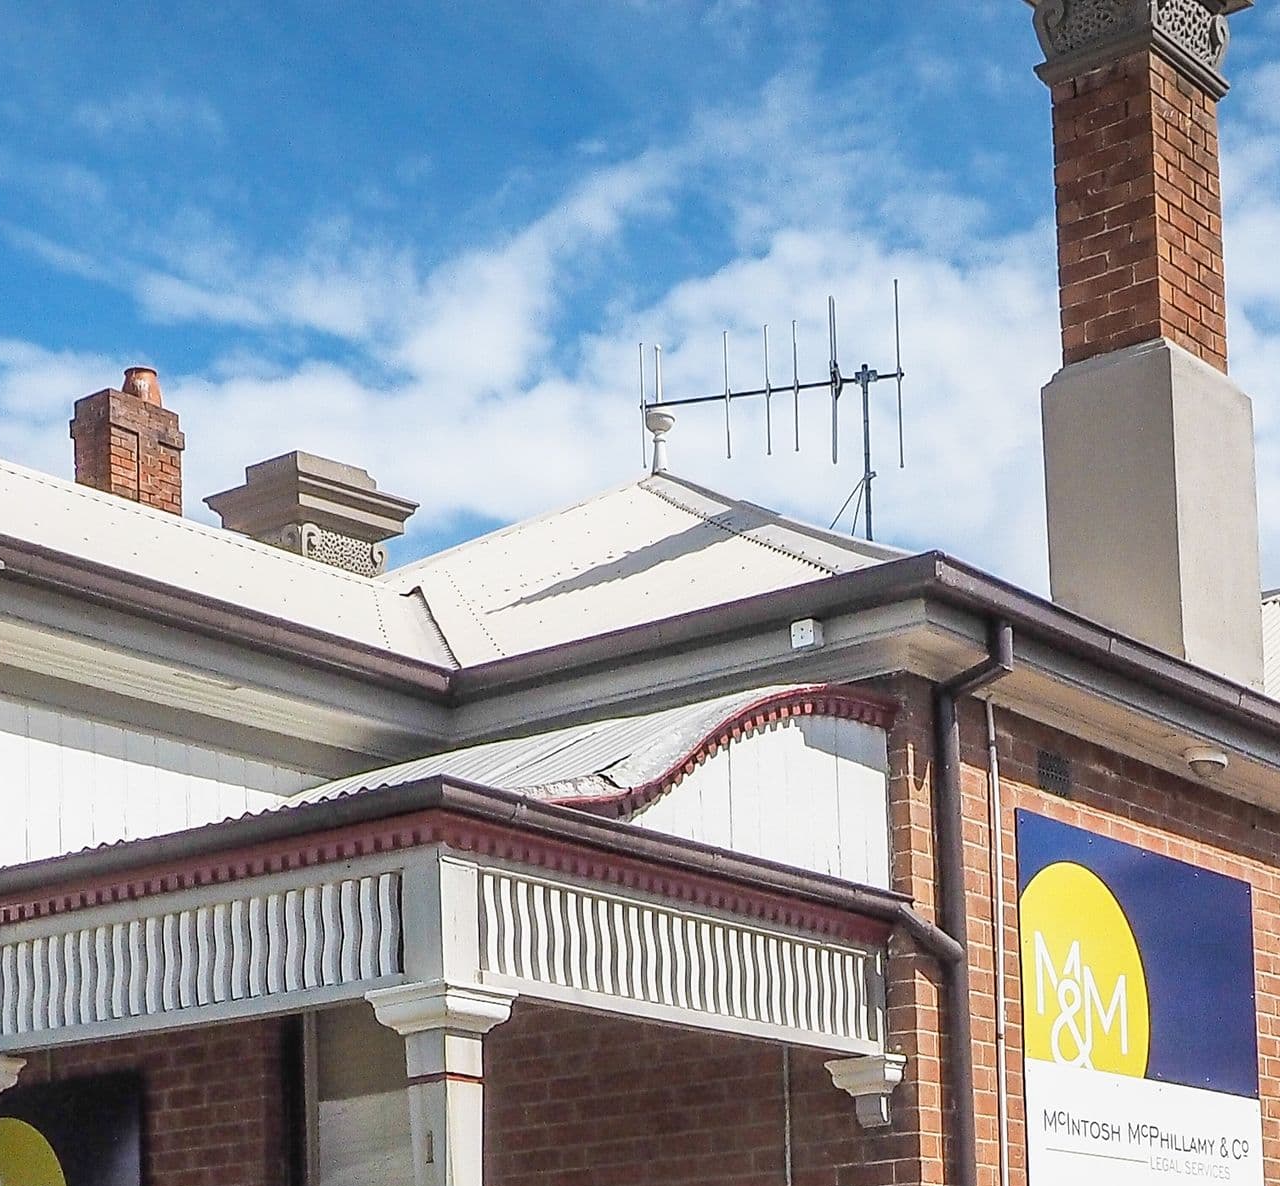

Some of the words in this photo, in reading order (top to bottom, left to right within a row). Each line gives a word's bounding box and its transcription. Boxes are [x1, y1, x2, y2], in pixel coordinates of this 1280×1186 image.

[1034, 930, 1128, 1072] M&M
[1219, 1136, 1229, 1158] &
[1150, 1156, 1182, 1175] LEGAL
[1184, 1161, 1231, 1181] SERVICES
